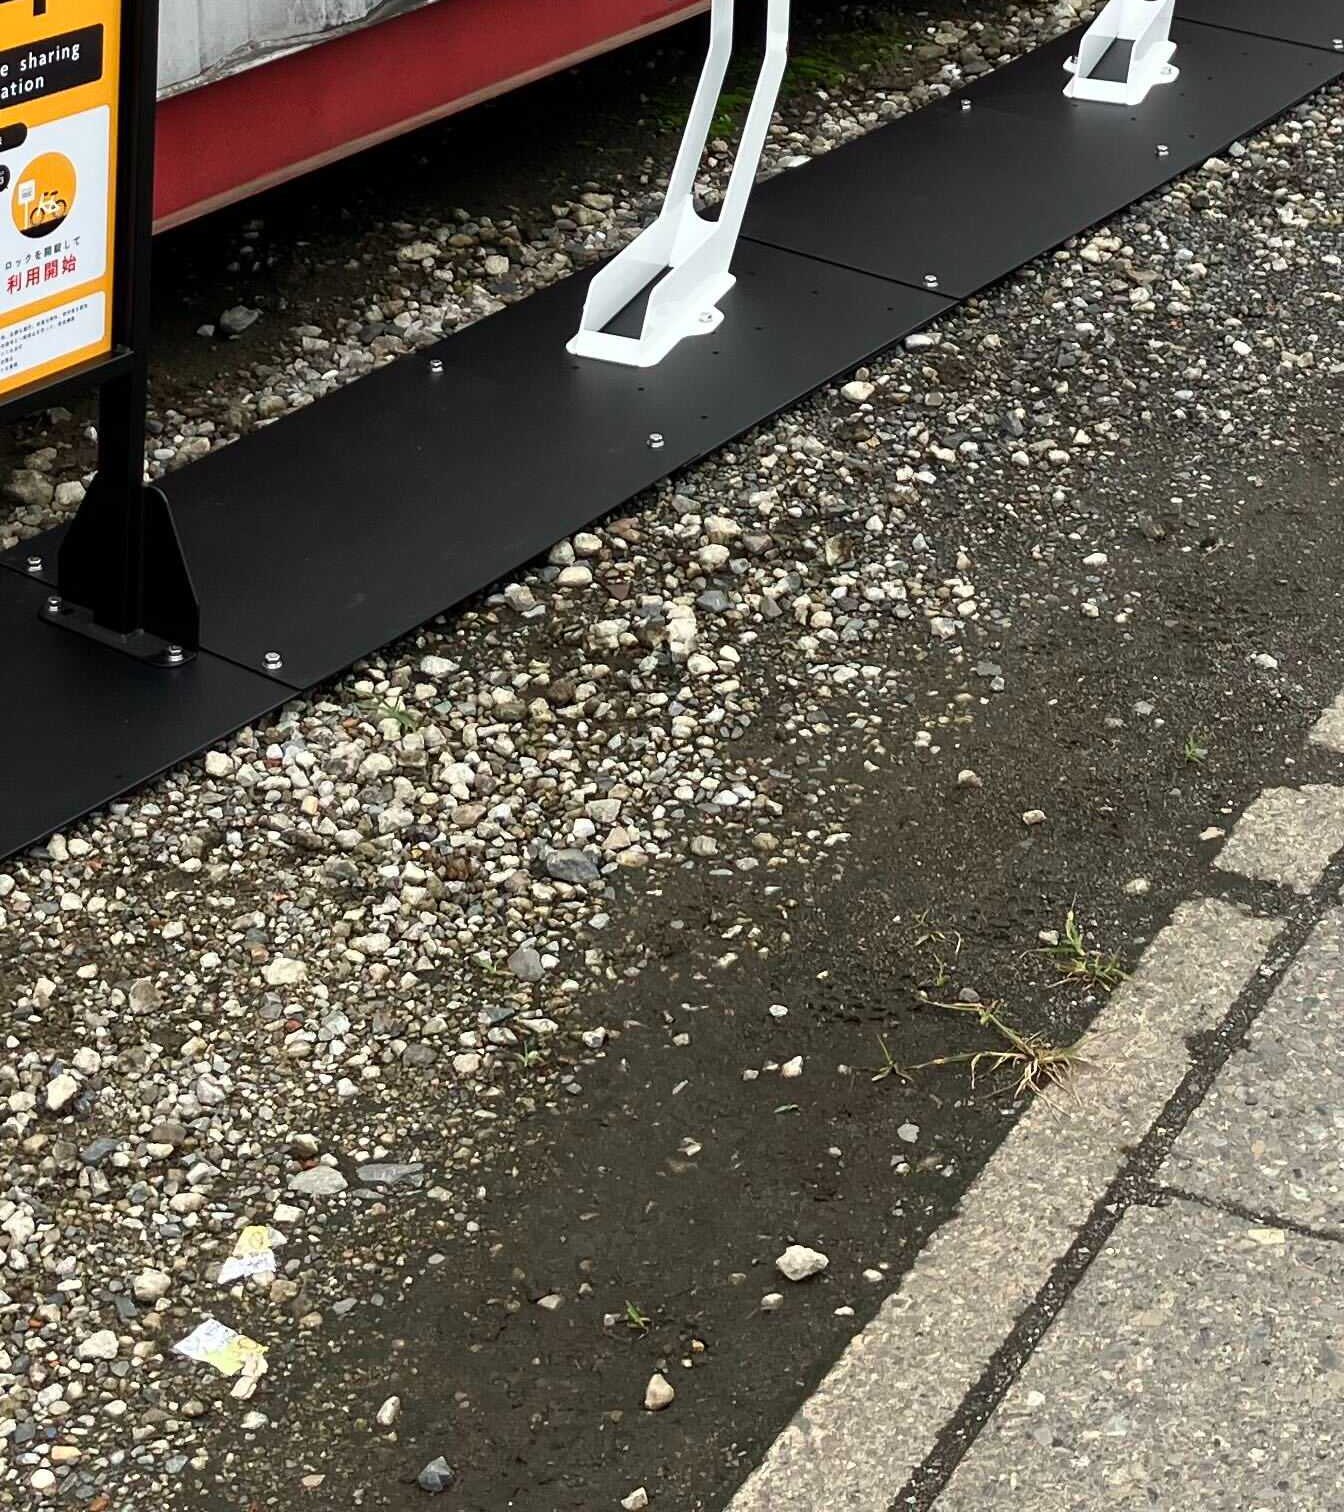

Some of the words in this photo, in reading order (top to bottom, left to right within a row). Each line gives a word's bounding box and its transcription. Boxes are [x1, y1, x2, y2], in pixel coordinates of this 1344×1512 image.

[19, 41, 81, 73] sharing
[6, 253, 77, 295] 利用開始
